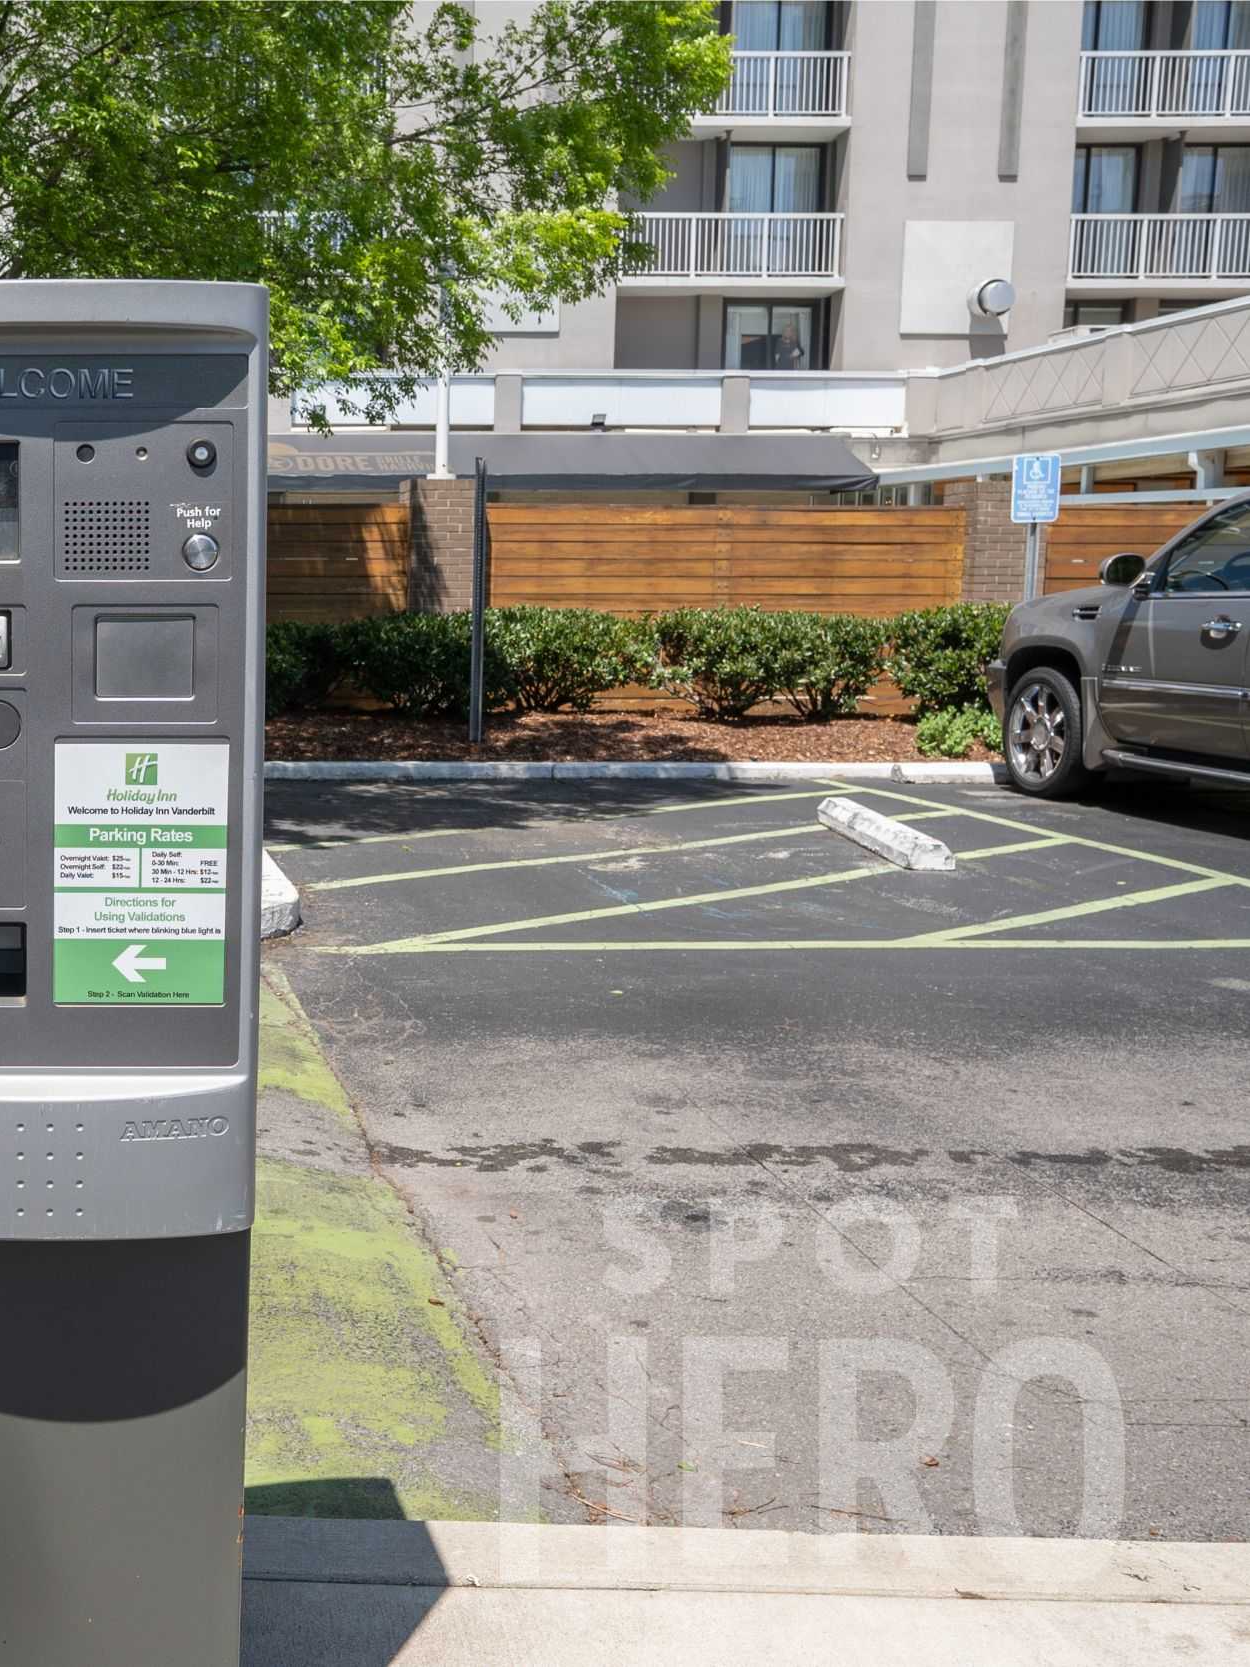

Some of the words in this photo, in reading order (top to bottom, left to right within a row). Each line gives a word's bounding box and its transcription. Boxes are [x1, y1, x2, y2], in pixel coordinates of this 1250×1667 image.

[176, 506, 202, 518] Push
[205, 506, 221, 517] for
[187, 518, 212, 530] Help
[107, 788, 155, 805] Holiday
[158, 789, 177, 802] Inn
[68, 806, 108, 815] Welcome
[111, 806, 119, 815] to
[121, 806, 154, 817] Holiday
[156, 807, 170, 815] Inn
[171, 806, 215, 816] Vanderbilt
[89, 828, 147, 845] Parking
[151, 828, 193, 842] Rates
[104, 897, 158, 907] Directions
[161, 897, 176, 907] for
[94, 912, 125, 923] Using
[128, 911, 186, 922] Validations
[58, 926, 75, 934] Step
[128, 926, 150, 934] where
[151, 926, 180, 935] blinking
[181, 926, 197, 934] blue
[198, 926, 214, 935] light
[87, 991, 104, 999] Step
[120, 1116, 230, 1141] AMANO
